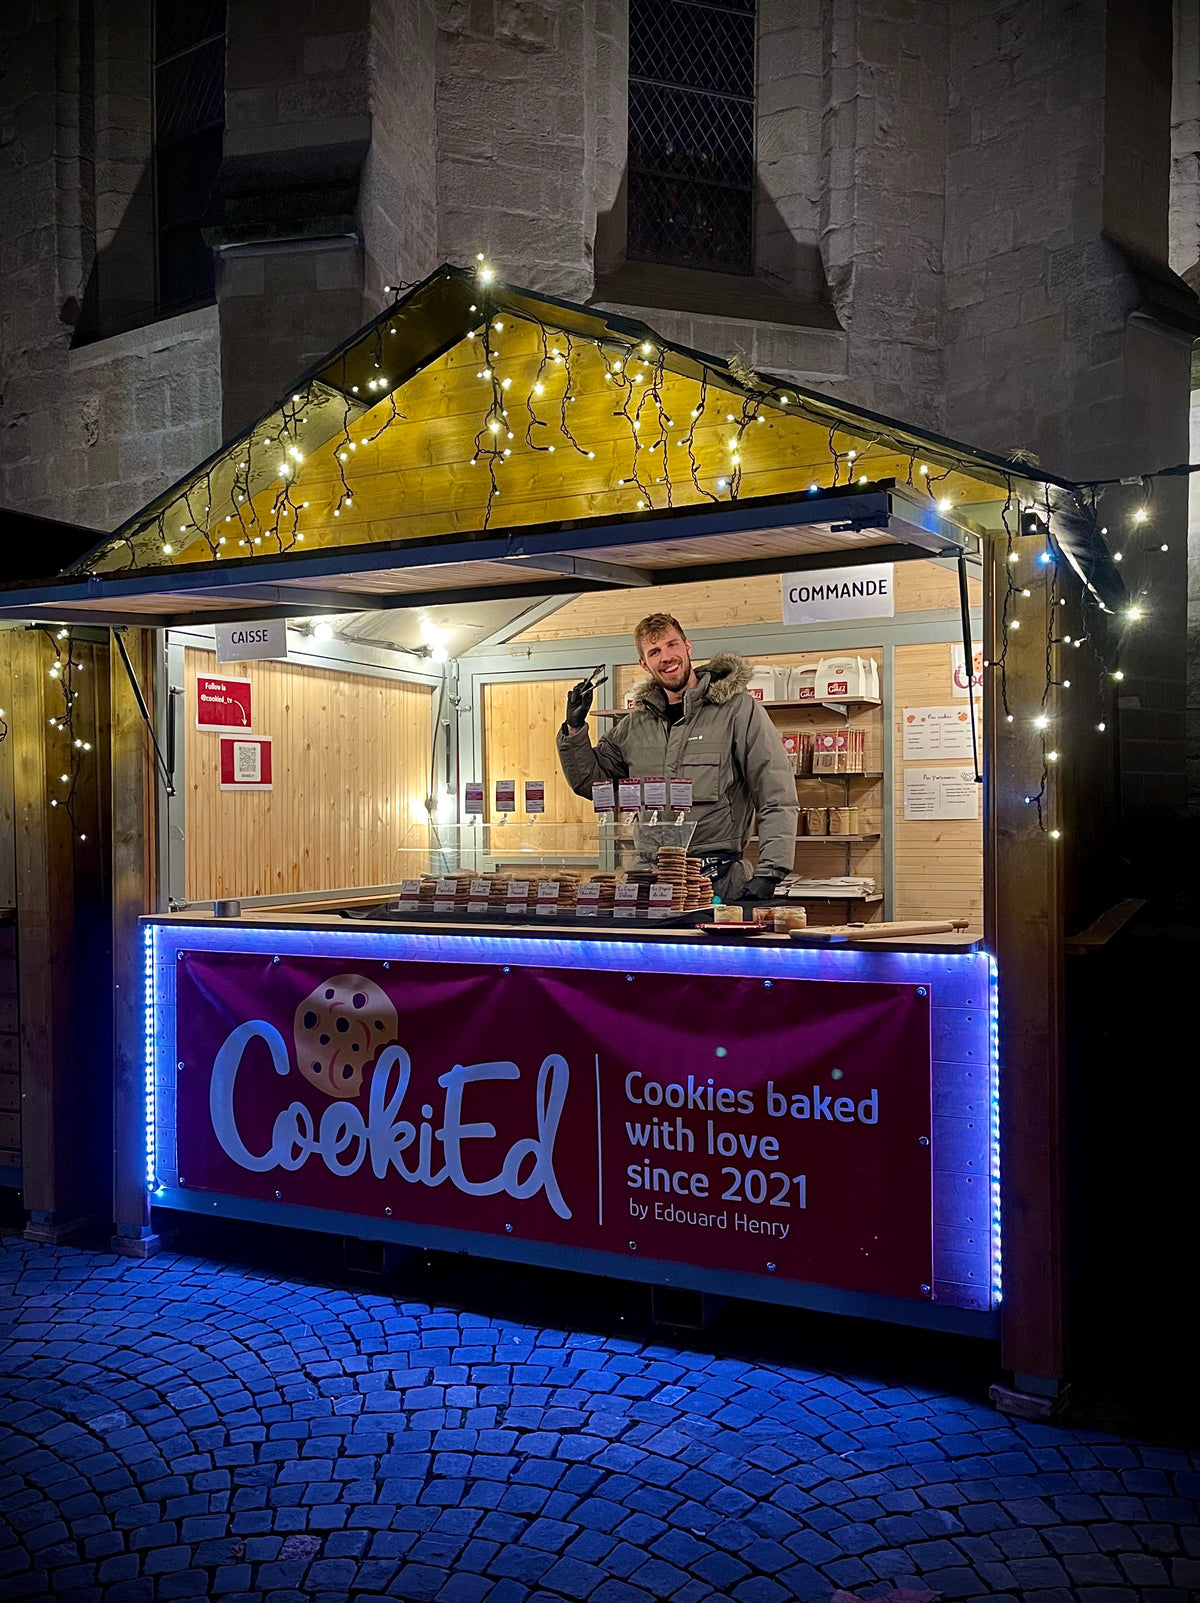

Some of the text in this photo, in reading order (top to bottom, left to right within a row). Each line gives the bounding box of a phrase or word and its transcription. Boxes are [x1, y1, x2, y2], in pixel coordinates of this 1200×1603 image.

[789, 579, 888, 603] COMMANDE
[231, 629, 269, 644] CAISSE
[205, 682, 221, 691] Follow
[209, 1019, 573, 1220] CookiEd
[624, 1071, 879, 1125] Cookies baked
[625, 1117, 780, 1161] with love
[627, 1159, 807, 1209] since 2021
[629, 1197, 790, 1239] by Edouard Henry
